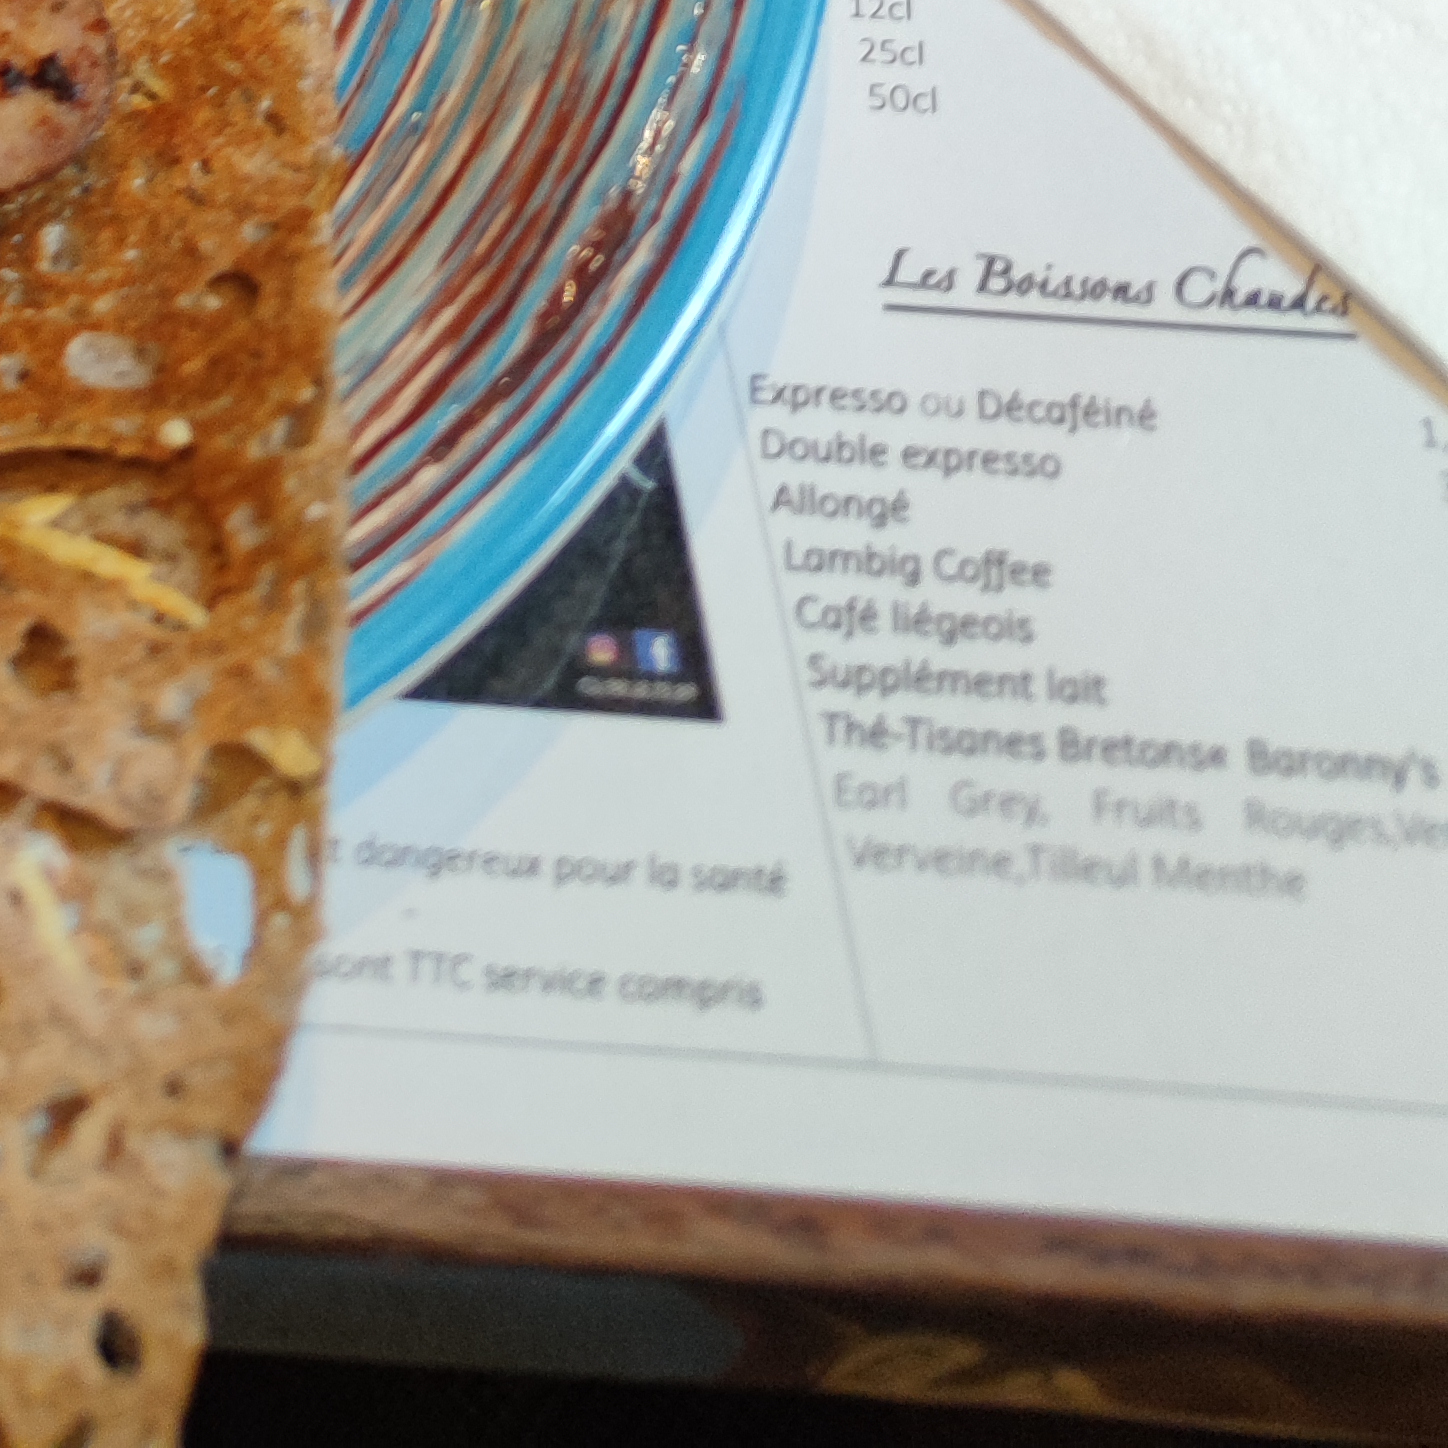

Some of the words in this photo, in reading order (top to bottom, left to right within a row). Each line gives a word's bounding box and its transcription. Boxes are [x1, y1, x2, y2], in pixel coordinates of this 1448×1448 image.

[860, 38, 923, 66] 25cl
[869, 83, 937, 114] 50cl
[879, 248, 956, 292] Les
[976, 253, 1156, 304] Boissons
[1174, 247, 1352, 316] Chaudes
[749, 373, 908, 415] Expresso
[919, 393, 965, 419] ou
[978, 388, 1157, 436] Décaféiné
[761, 429, 888, 468] Double
[900, 445, 1062, 480] expresso
[770, 483, 910, 529] Allongé
[784, 540, 922, 588] Lambig
[933, 547, 1053, 593] Coffee
[795, 595, 877, 640] Café
[892, 602, 1036, 647] liégeois
[807, 652, 1034, 703] Supplément
[1047, 667, 1109, 708] lait
[407, 949, 474, 992] TTC
[484, 964, 606, 999] service
[618, 972, 765, 1014] compris
